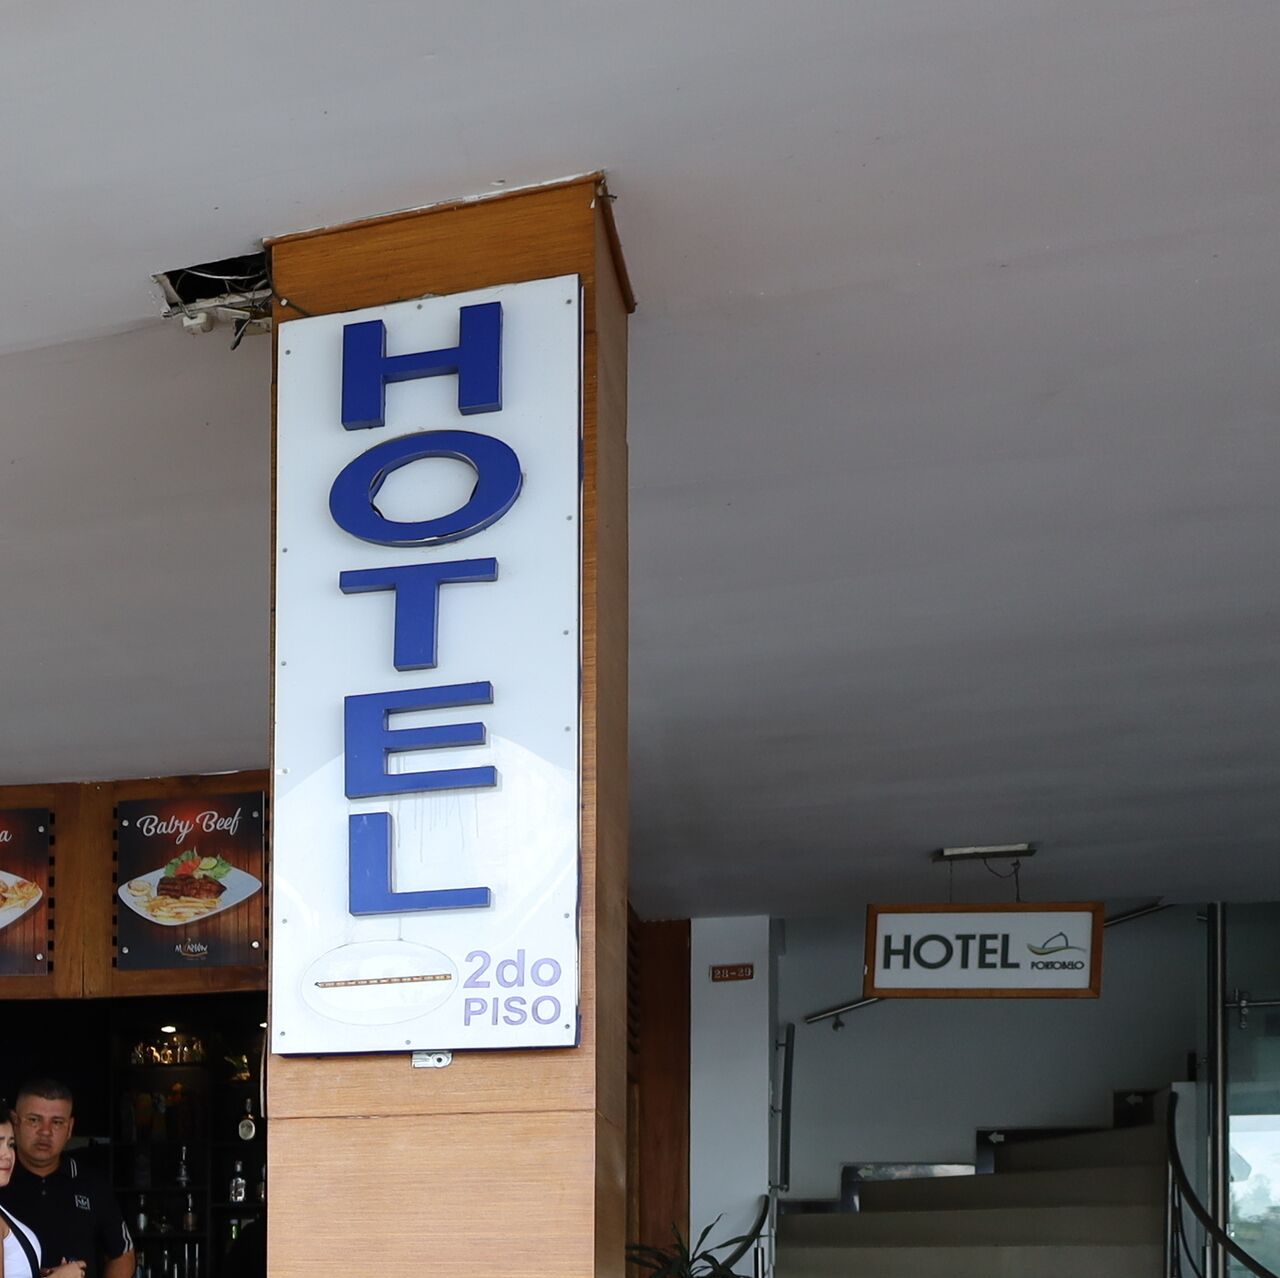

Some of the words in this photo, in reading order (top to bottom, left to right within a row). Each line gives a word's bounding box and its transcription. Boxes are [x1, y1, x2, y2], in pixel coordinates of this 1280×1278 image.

[329, 301, 523, 917] HOTEL
[137, 814, 194, 844] Baby
[195, 807, 243, 835] Beef
[462, 949, 561, 989] 2do
[882, 933, 1021, 970] HOTEL
[462, 995, 561, 1027] PISO
